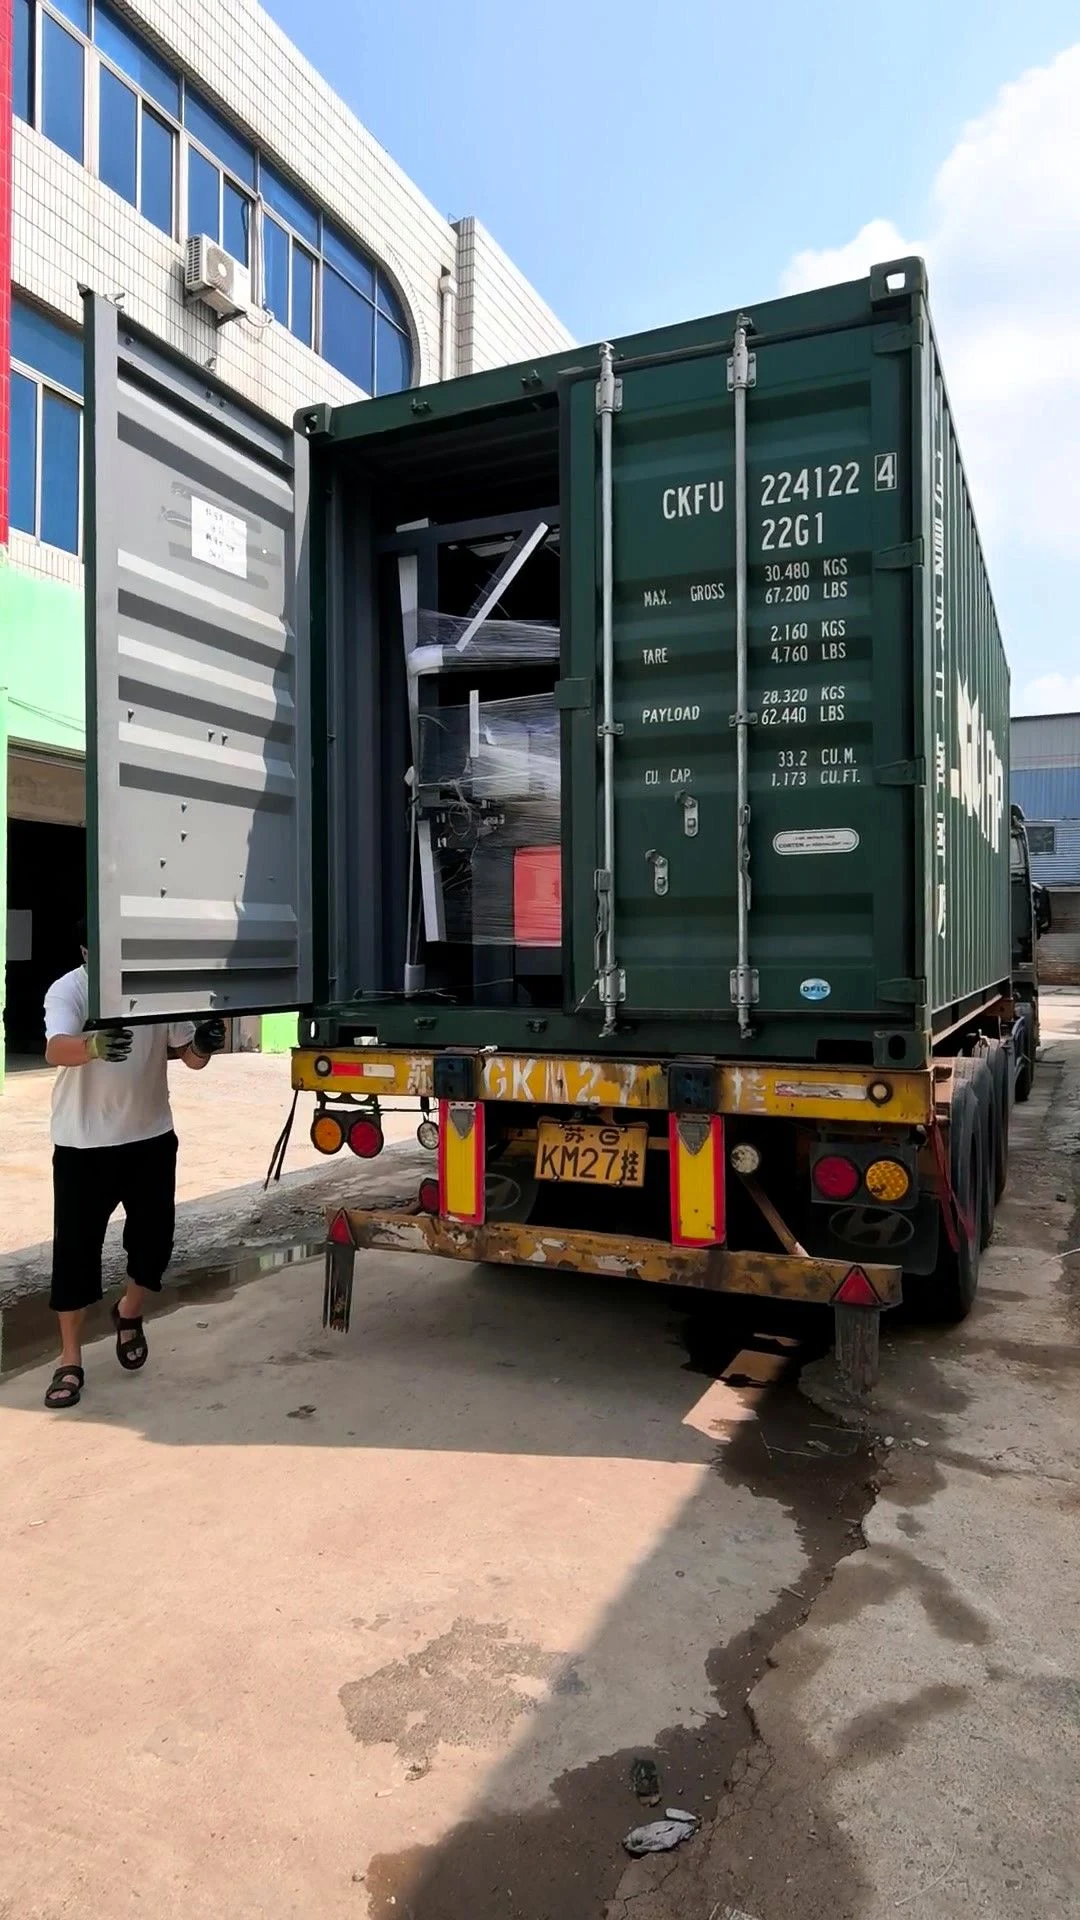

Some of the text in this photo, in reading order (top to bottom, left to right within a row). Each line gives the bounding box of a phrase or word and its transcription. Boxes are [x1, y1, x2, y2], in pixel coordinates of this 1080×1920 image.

[663, 455, 895, 519] CKFU 224122 4
[762, 512, 822, 550] 22G1
[765, 558, 847, 581] 30.480 KGS
[644, 583, 725, 607] MAX. GROSS
[766, 581, 847, 604] 67.200 LBS
[771, 620, 845, 641] 2.160 KGS
[643, 648, 667, 664] TARE
[771, 642, 846, 663] 4.760 LBS
[763, 686, 845, 704] 28.320 KGS
[643, 706, 699, 723] PAYLOAD
[762, 705, 844, 724] 62.440 LBS
[779, 751, 807, 767] 33.2
[646, 769, 692, 785] CU. CAP.
[772, 772, 806, 786] 1.173
[541, 1144, 639, 1181] KM27挂
